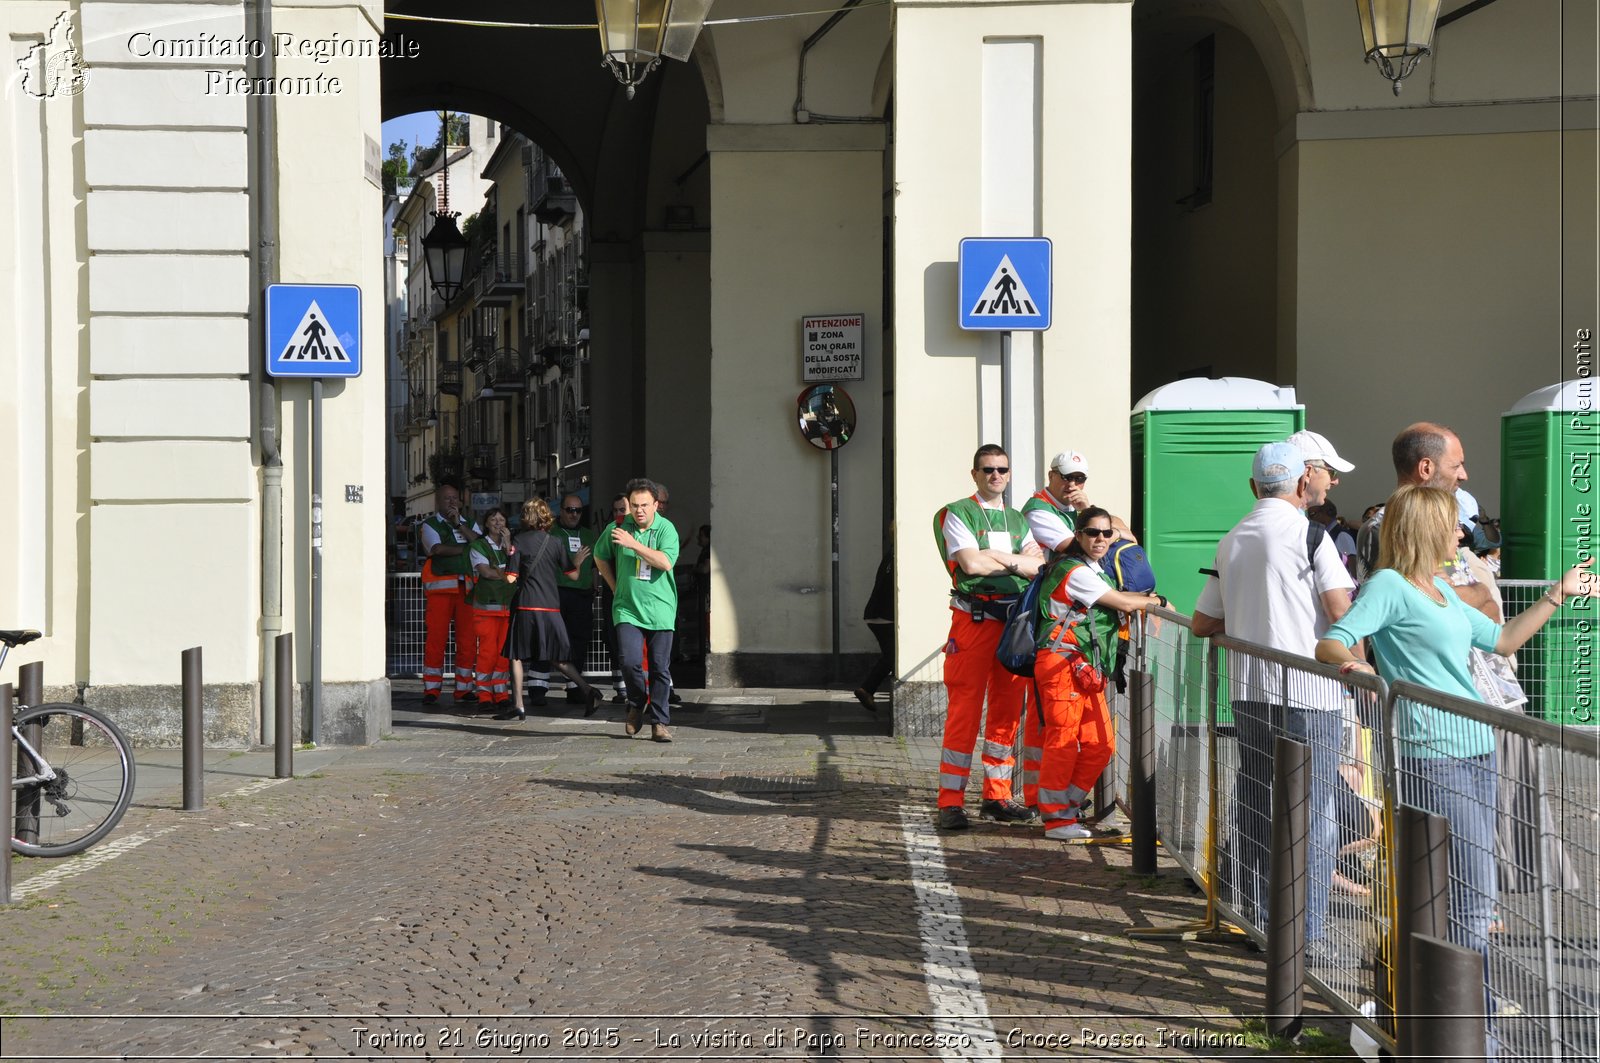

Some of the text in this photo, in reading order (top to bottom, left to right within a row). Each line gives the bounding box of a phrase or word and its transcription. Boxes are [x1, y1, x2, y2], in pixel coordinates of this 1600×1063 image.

[805, 317, 860, 328] ATTENZIONE
[820, 330, 844, 339] ZONA
[809, 342, 855, 351] CON ORARI
[805, 354, 860, 363] DELLA SOSTA
[809, 366, 856, 374] MODIFICATI
[472, 494, 499, 505] fresh
